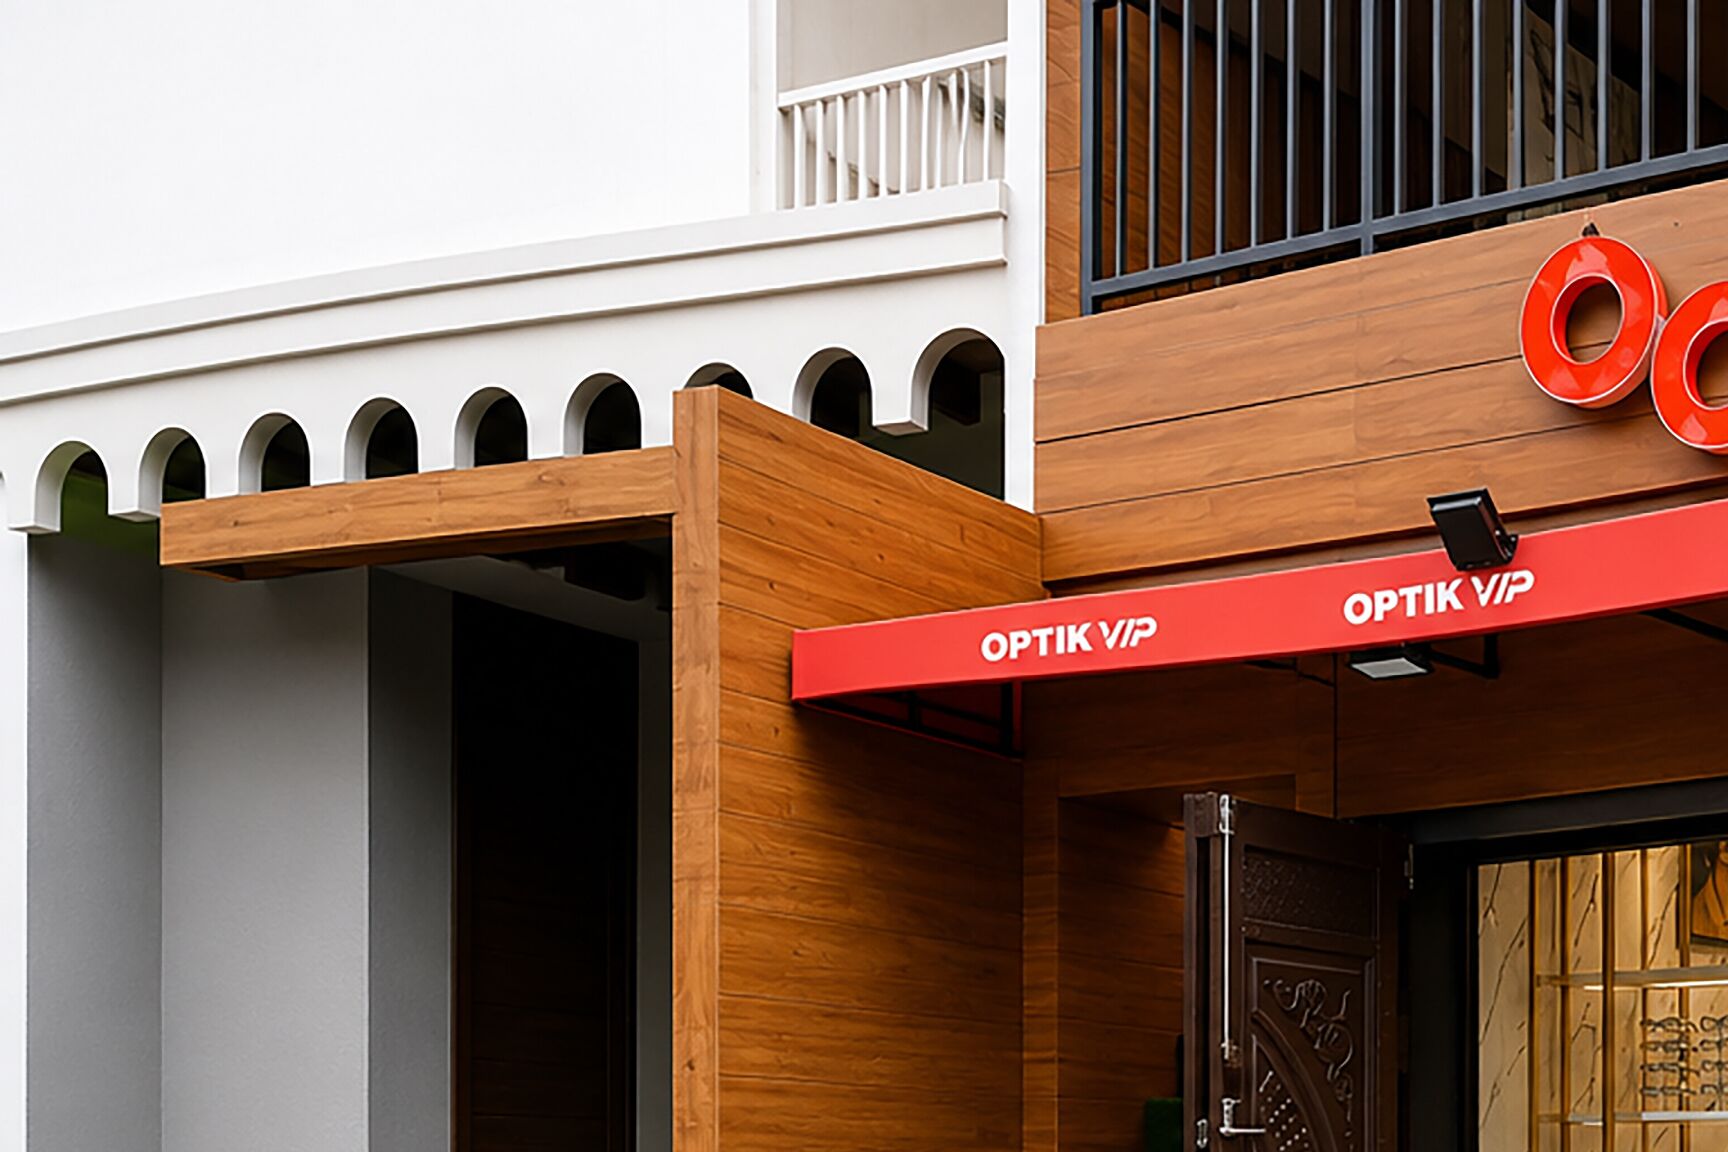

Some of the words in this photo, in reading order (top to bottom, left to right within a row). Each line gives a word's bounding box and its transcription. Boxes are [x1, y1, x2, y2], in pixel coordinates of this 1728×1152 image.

[1343, 578, 1465, 625] OPTIK
[1471, 569, 1535, 607] VIP
[981, 622, 1093, 661] OPTIK
[1098, 616, 1157, 650] VIP
